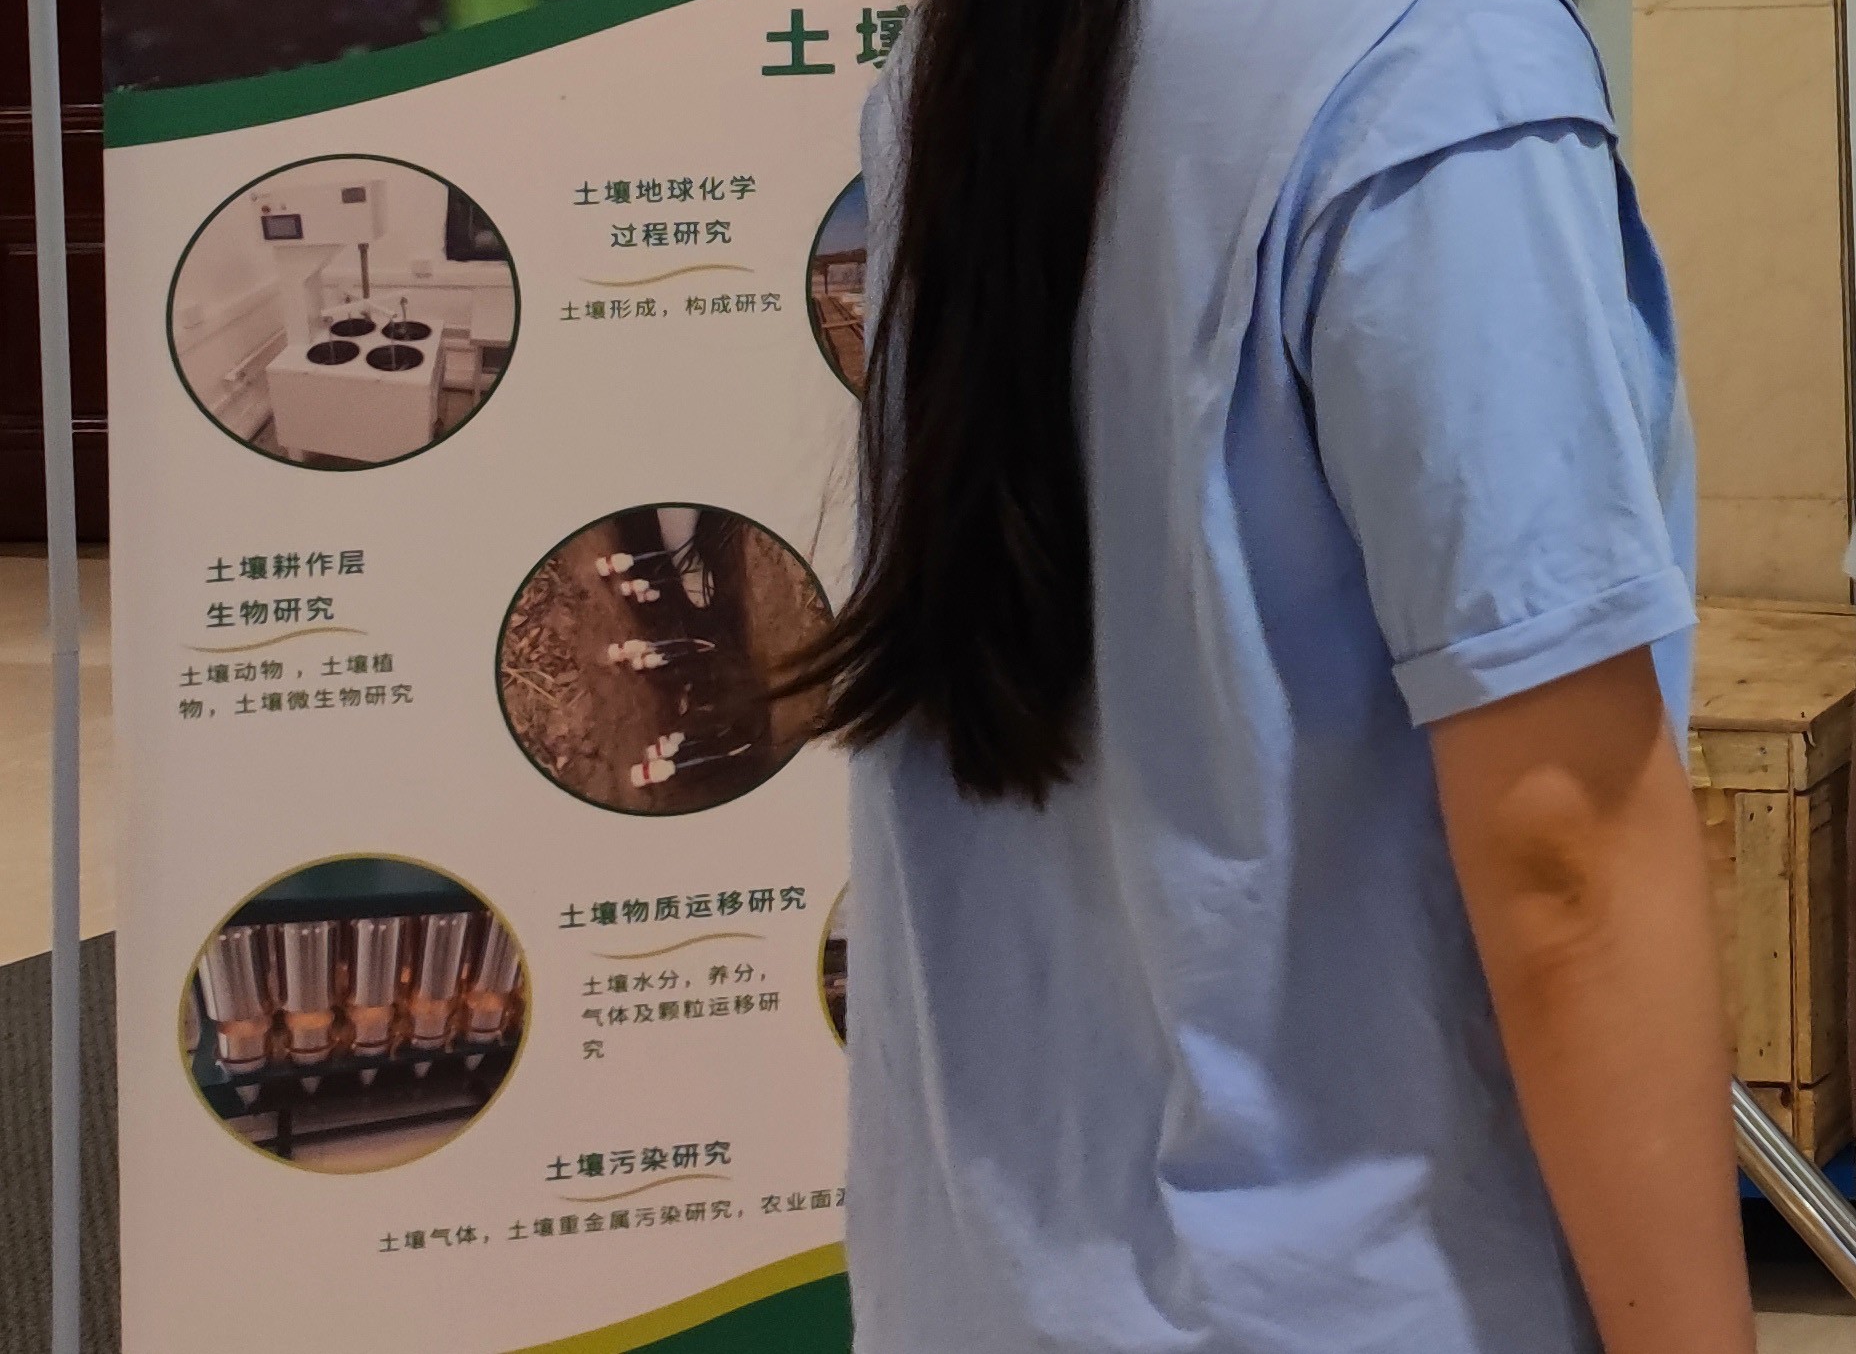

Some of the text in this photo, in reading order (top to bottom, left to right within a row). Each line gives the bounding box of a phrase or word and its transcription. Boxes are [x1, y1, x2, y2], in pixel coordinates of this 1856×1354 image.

[573, 175, 756, 206] 土壤地球化学
[610, 219, 732, 247] 过程研究
[559, 292, 783, 321] 土壤形成，构成研究
[205, 549, 366, 584] 土壤耕作层
[206, 596, 335, 628] 生物研究
[179, 653, 394, 687] 土壤动物，土壤植
[178, 683, 414, 720] 物，土壤微生物研究
[558, 885, 807, 929] 土壤物质运移研究
[581, 992, 780, 1027] 气体及颗粒运移研
[582, 1039, 605, 1060] 究
[545, 1140, 732, 1182] 土壤污染研究
